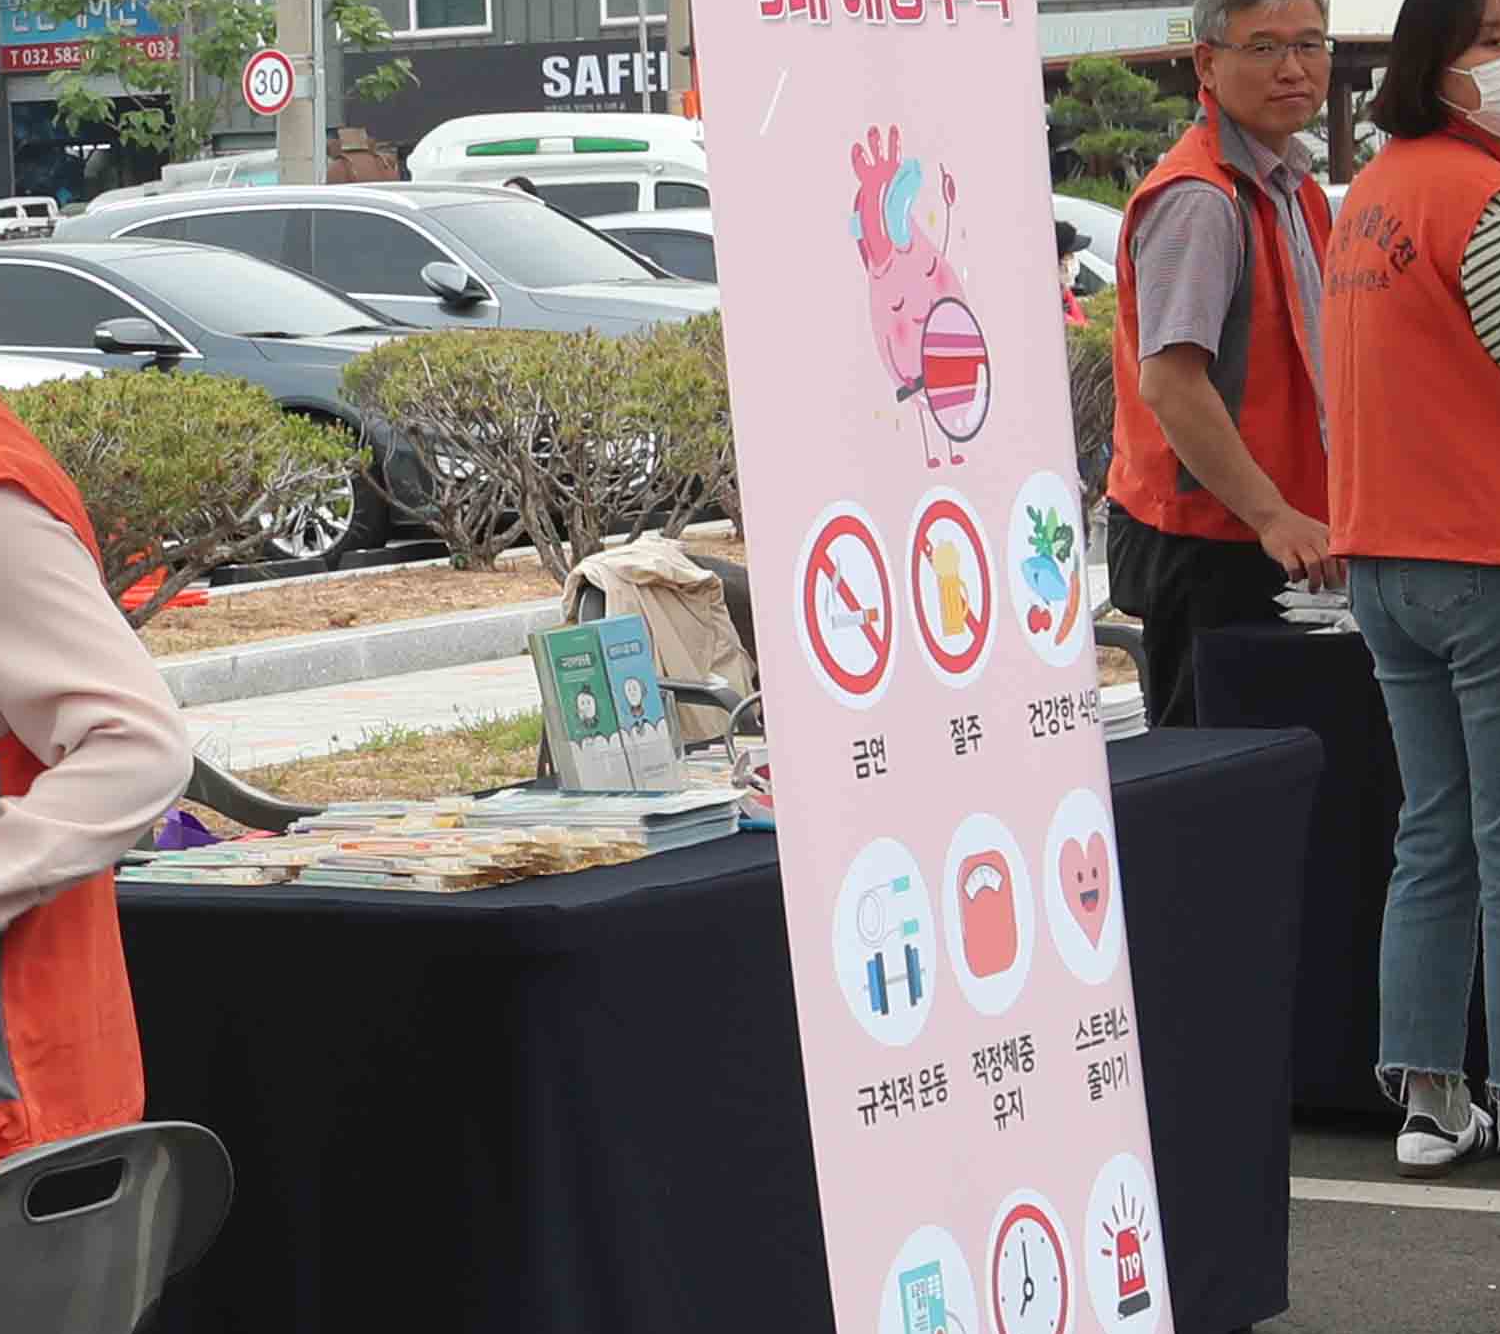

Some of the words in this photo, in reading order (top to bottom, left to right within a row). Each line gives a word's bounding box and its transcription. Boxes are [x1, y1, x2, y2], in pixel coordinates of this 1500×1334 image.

[9, 51, 19, 66] T
[253, 68, 285, 98] 30
[949, 714, 983, 756] 절주
[1027, 691, 1076, 739] 건강한
[851, 734, 887, 780] 금연
[1073, 1005, 1131, 1051] 스트레스
[971, 1034, 1036, 1086] 적정체중
[1086, 1052, 1131, 1101] 줄이기
[856, 1072, 917, 1127] 규칙적
[918, 1062, 949, 1109] 운동
[992, 1086, 1025, 1132] 유지
[1119, 1251, 1143, 1284] 119
